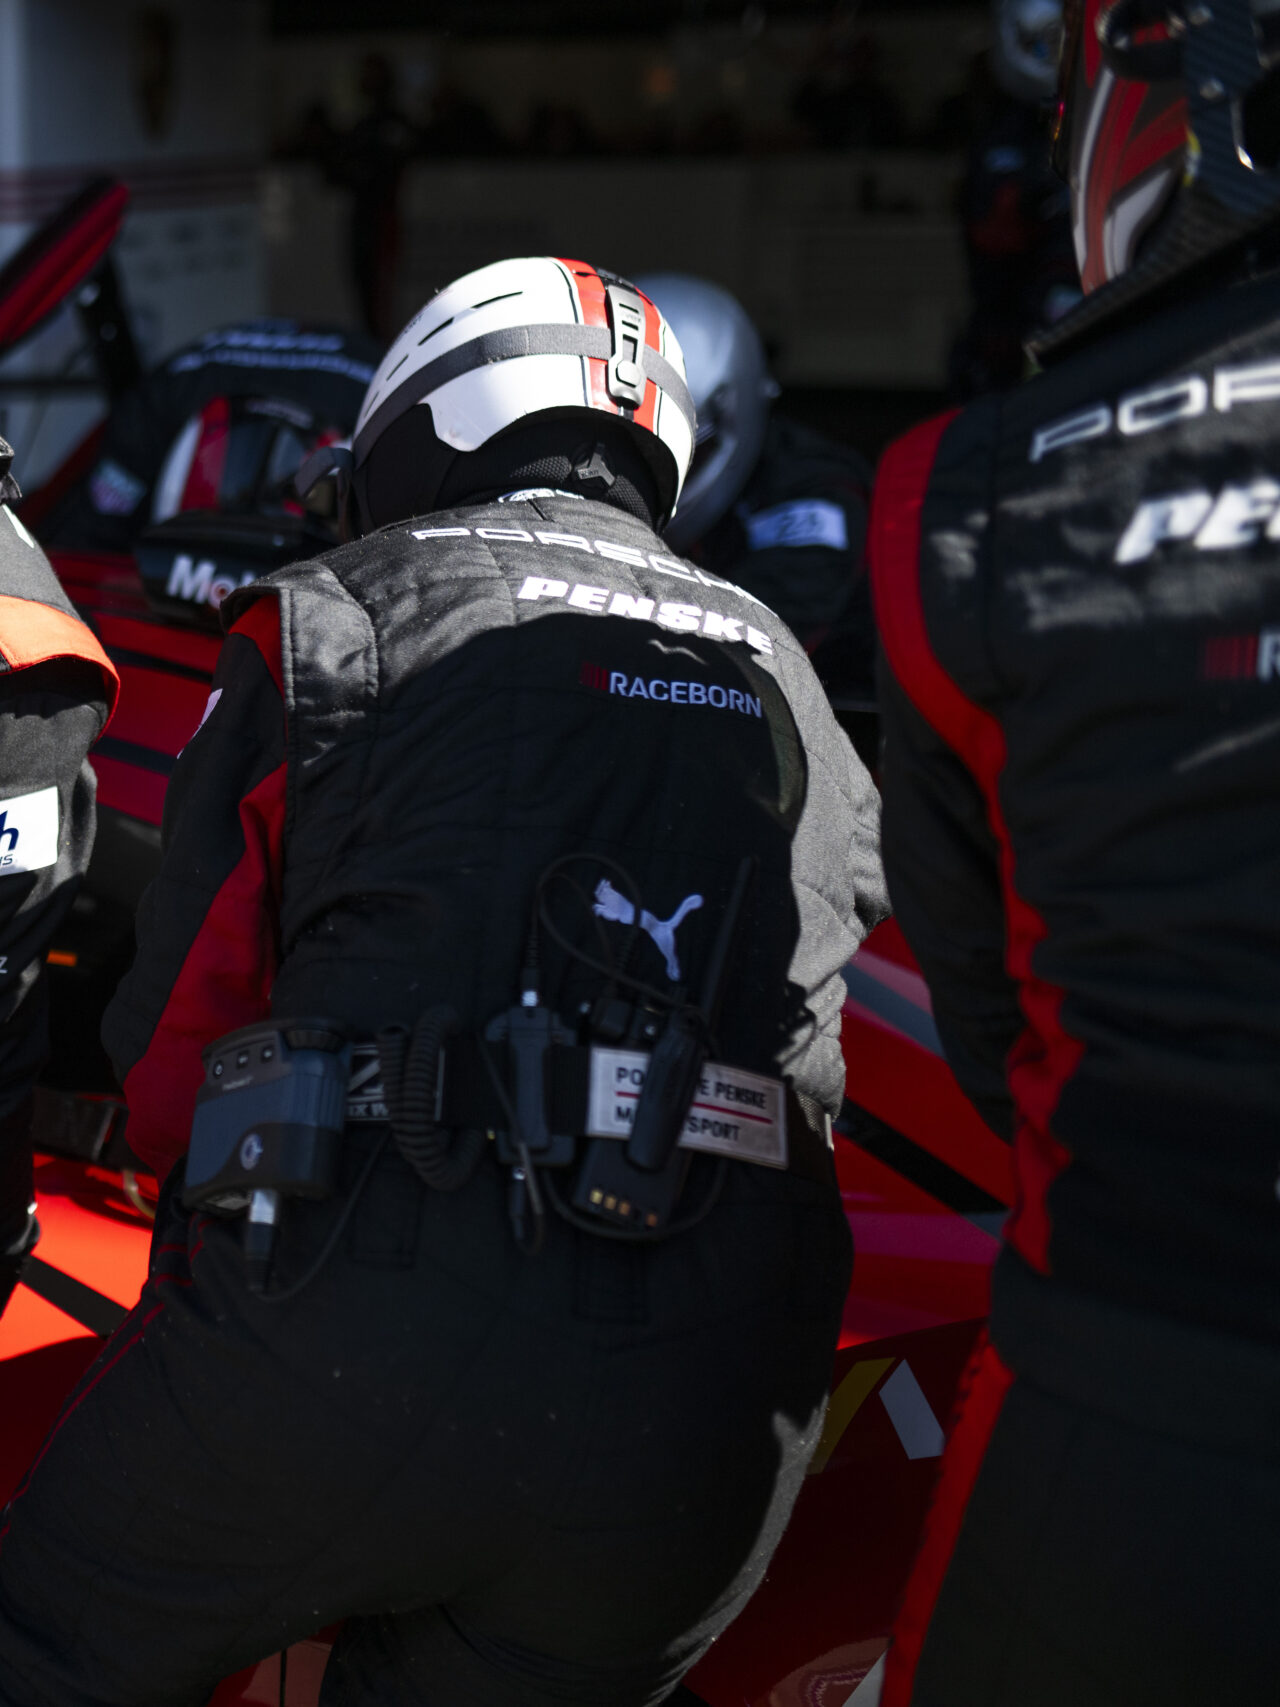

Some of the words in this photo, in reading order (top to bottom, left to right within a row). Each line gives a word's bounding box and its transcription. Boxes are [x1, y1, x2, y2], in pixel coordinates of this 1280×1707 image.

[166, 554, 257, 608] Mo
[517, 576, 773, 656] PENSKE
[609, 671, 763, 719] RACEBORN
